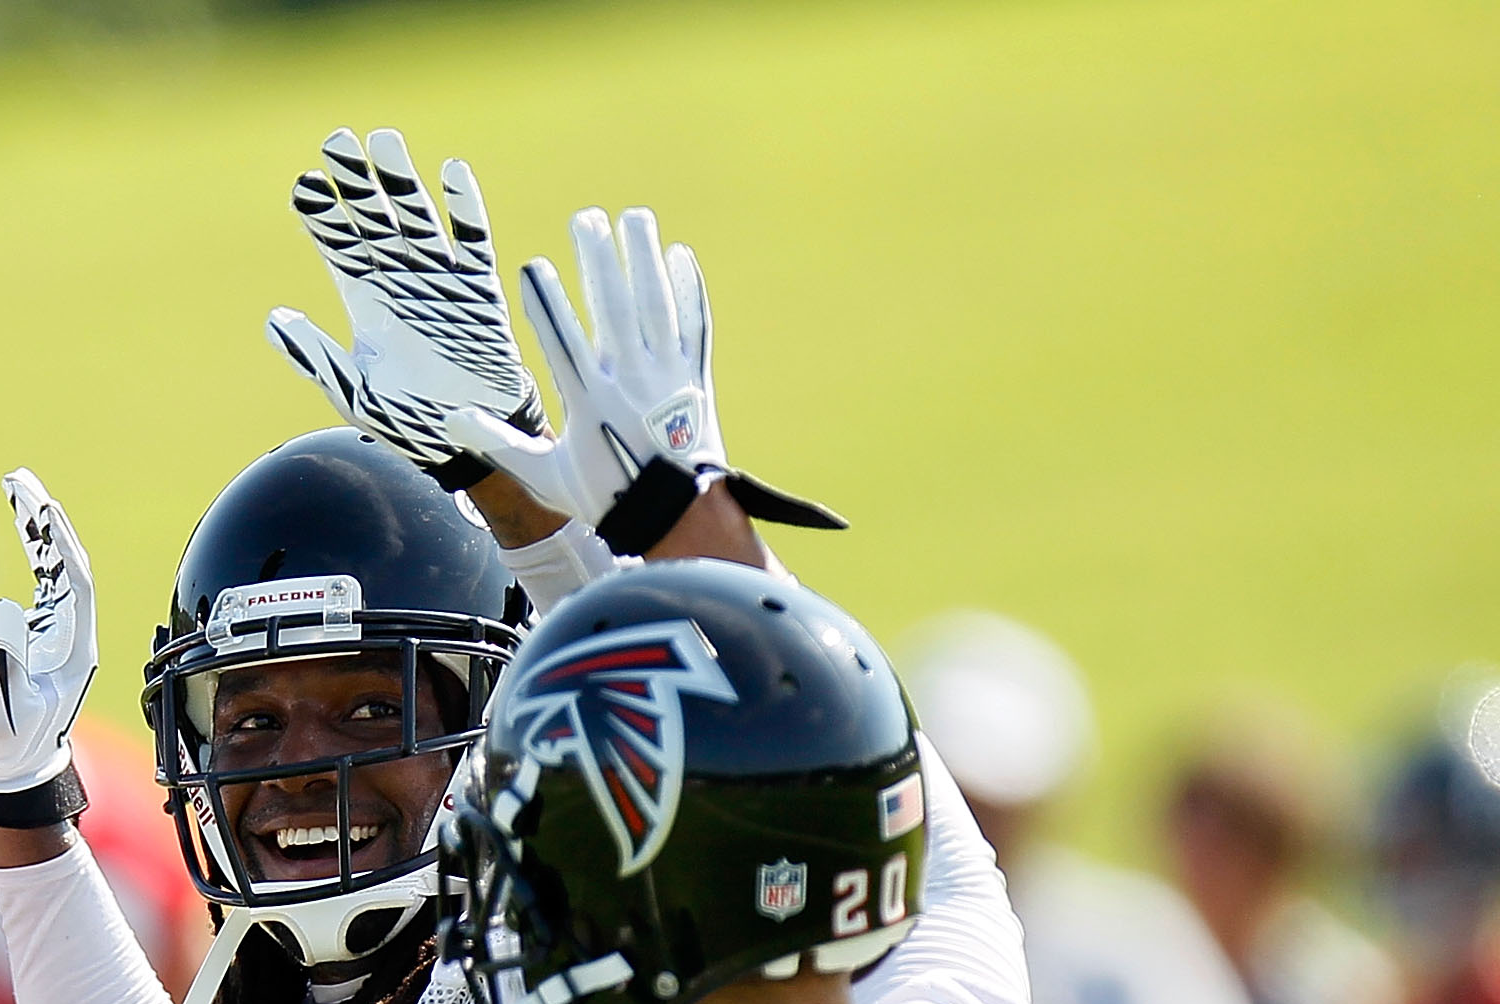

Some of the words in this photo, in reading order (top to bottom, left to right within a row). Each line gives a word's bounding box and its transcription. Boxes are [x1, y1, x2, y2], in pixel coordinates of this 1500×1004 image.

[248, 590, 325, 607] FALCONS
[766, 884, 802, 908] NFL
[833, 852, 908, 938] 20
